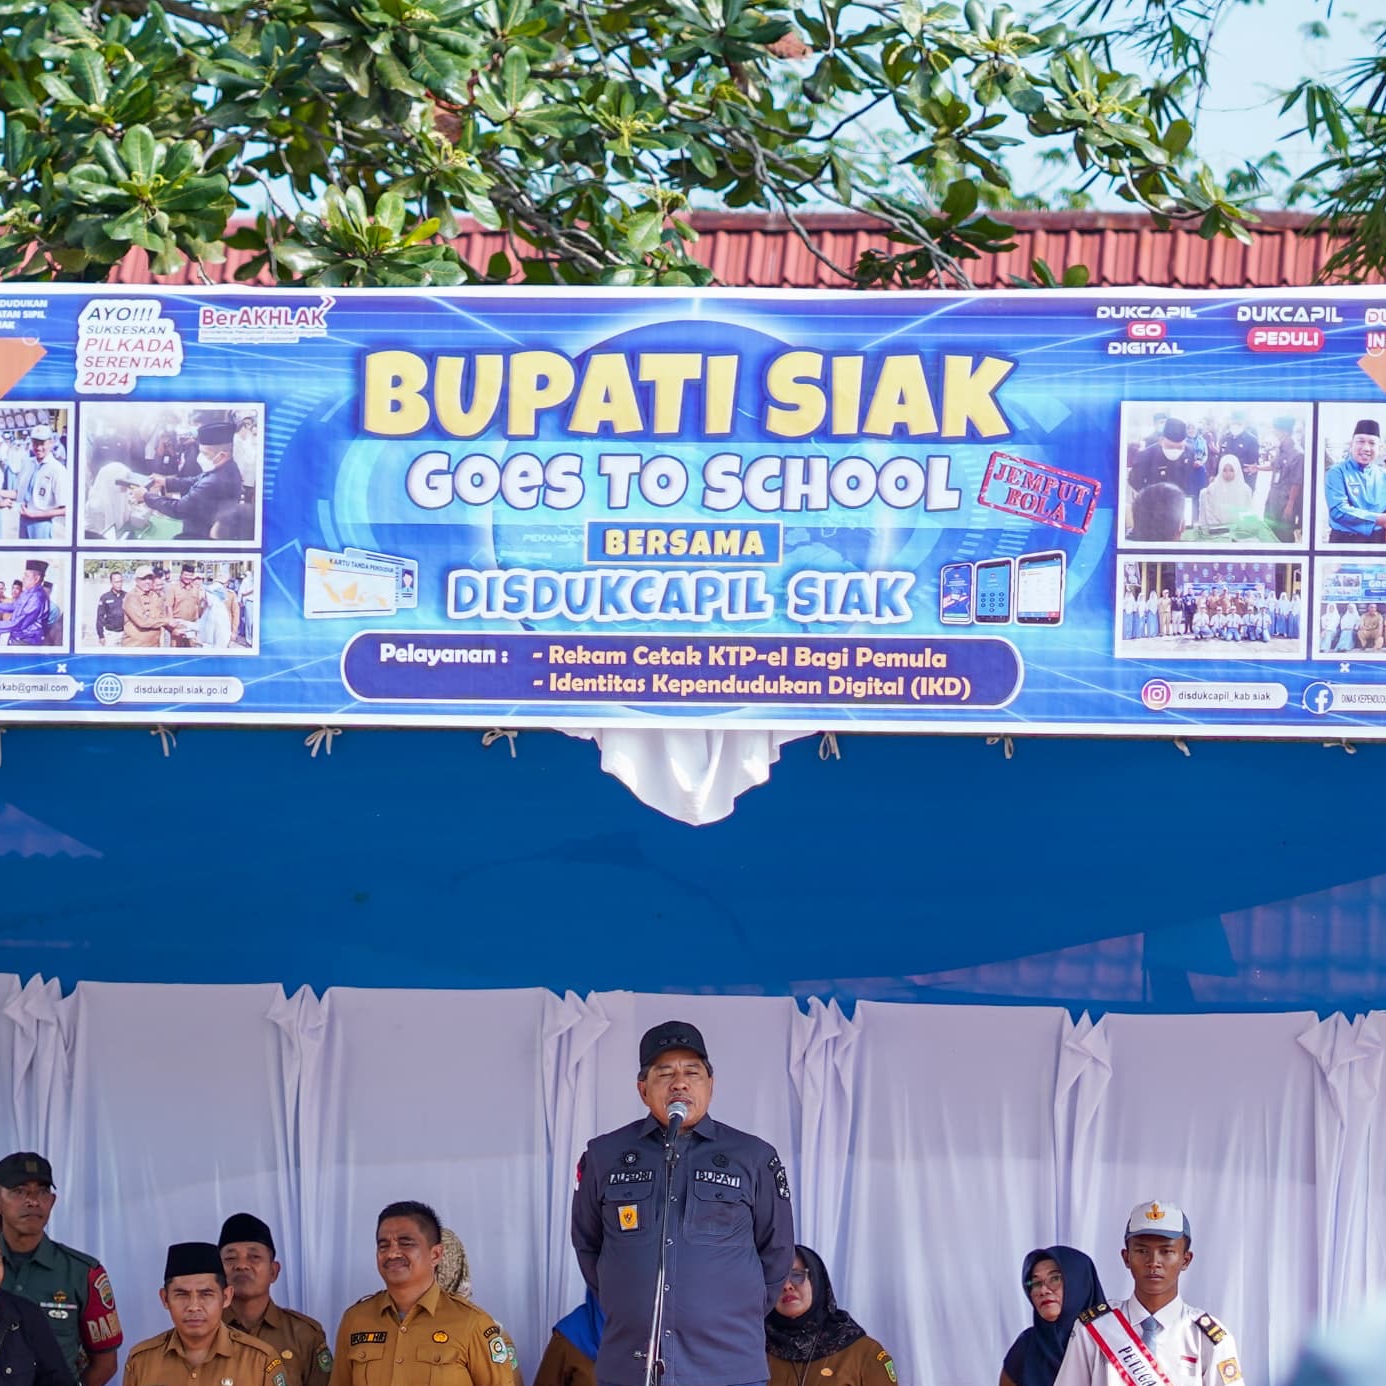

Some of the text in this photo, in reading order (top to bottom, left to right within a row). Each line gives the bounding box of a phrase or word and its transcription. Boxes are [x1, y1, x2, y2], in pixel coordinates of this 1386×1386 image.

[22, 310, 47, 319] SIPIL
[87, 306, 154, 322] AYO!!!
[202, 308, 325, 326] BerAKHLAK
[1096, 306, 1198, 320] DUKCAPIL
[1236, 306, 1344, 323] DUKCAPIL
[85, 325, 167, 335] SUKSESKAN
[1131, 323, 1162, 337] GO
[84, 338, 175, 353] PILKADA
[1253, 331, 1319, 347] PEDULI
[1107, 342, 1185, 355] DIGITAL
[83, 356, 174, 369] SERENTAK
[82, 372, 130, 387] 2024
[363, 349, 1016, 438] BUPATI SIAK
[598, 453, 689, 510] TO
[703, 453, 961, 511] SCHOOL
[993, 462, 1091, 506] JEMPUT
[1005, 486, 1067, 522] BOLA
[604, 528, 766, 556] BERSAMA
[450, 570, 914, 620] DISDUKCAPIL SIAK
[379, 642, 496, 667] Pelayanan
[548, 644, 627, 666] Rekam
[633, 645, 701, 666] Cetak
[708, 646, 789, 668] KTP-el
[794, 647, 849, 670] Bagi
[856, 648, 948, 669] Pemula
[549, 672, 646, 693] Identitas
[652, 674, 822, 699] Kependudukan
[827, 676, 904, 699] Digital
[910, 677, 972, 701] (IKD)
[608, 1170, 653, 1185] ALFEDRI
[694, 1170, 741, 1189] BUPATI
